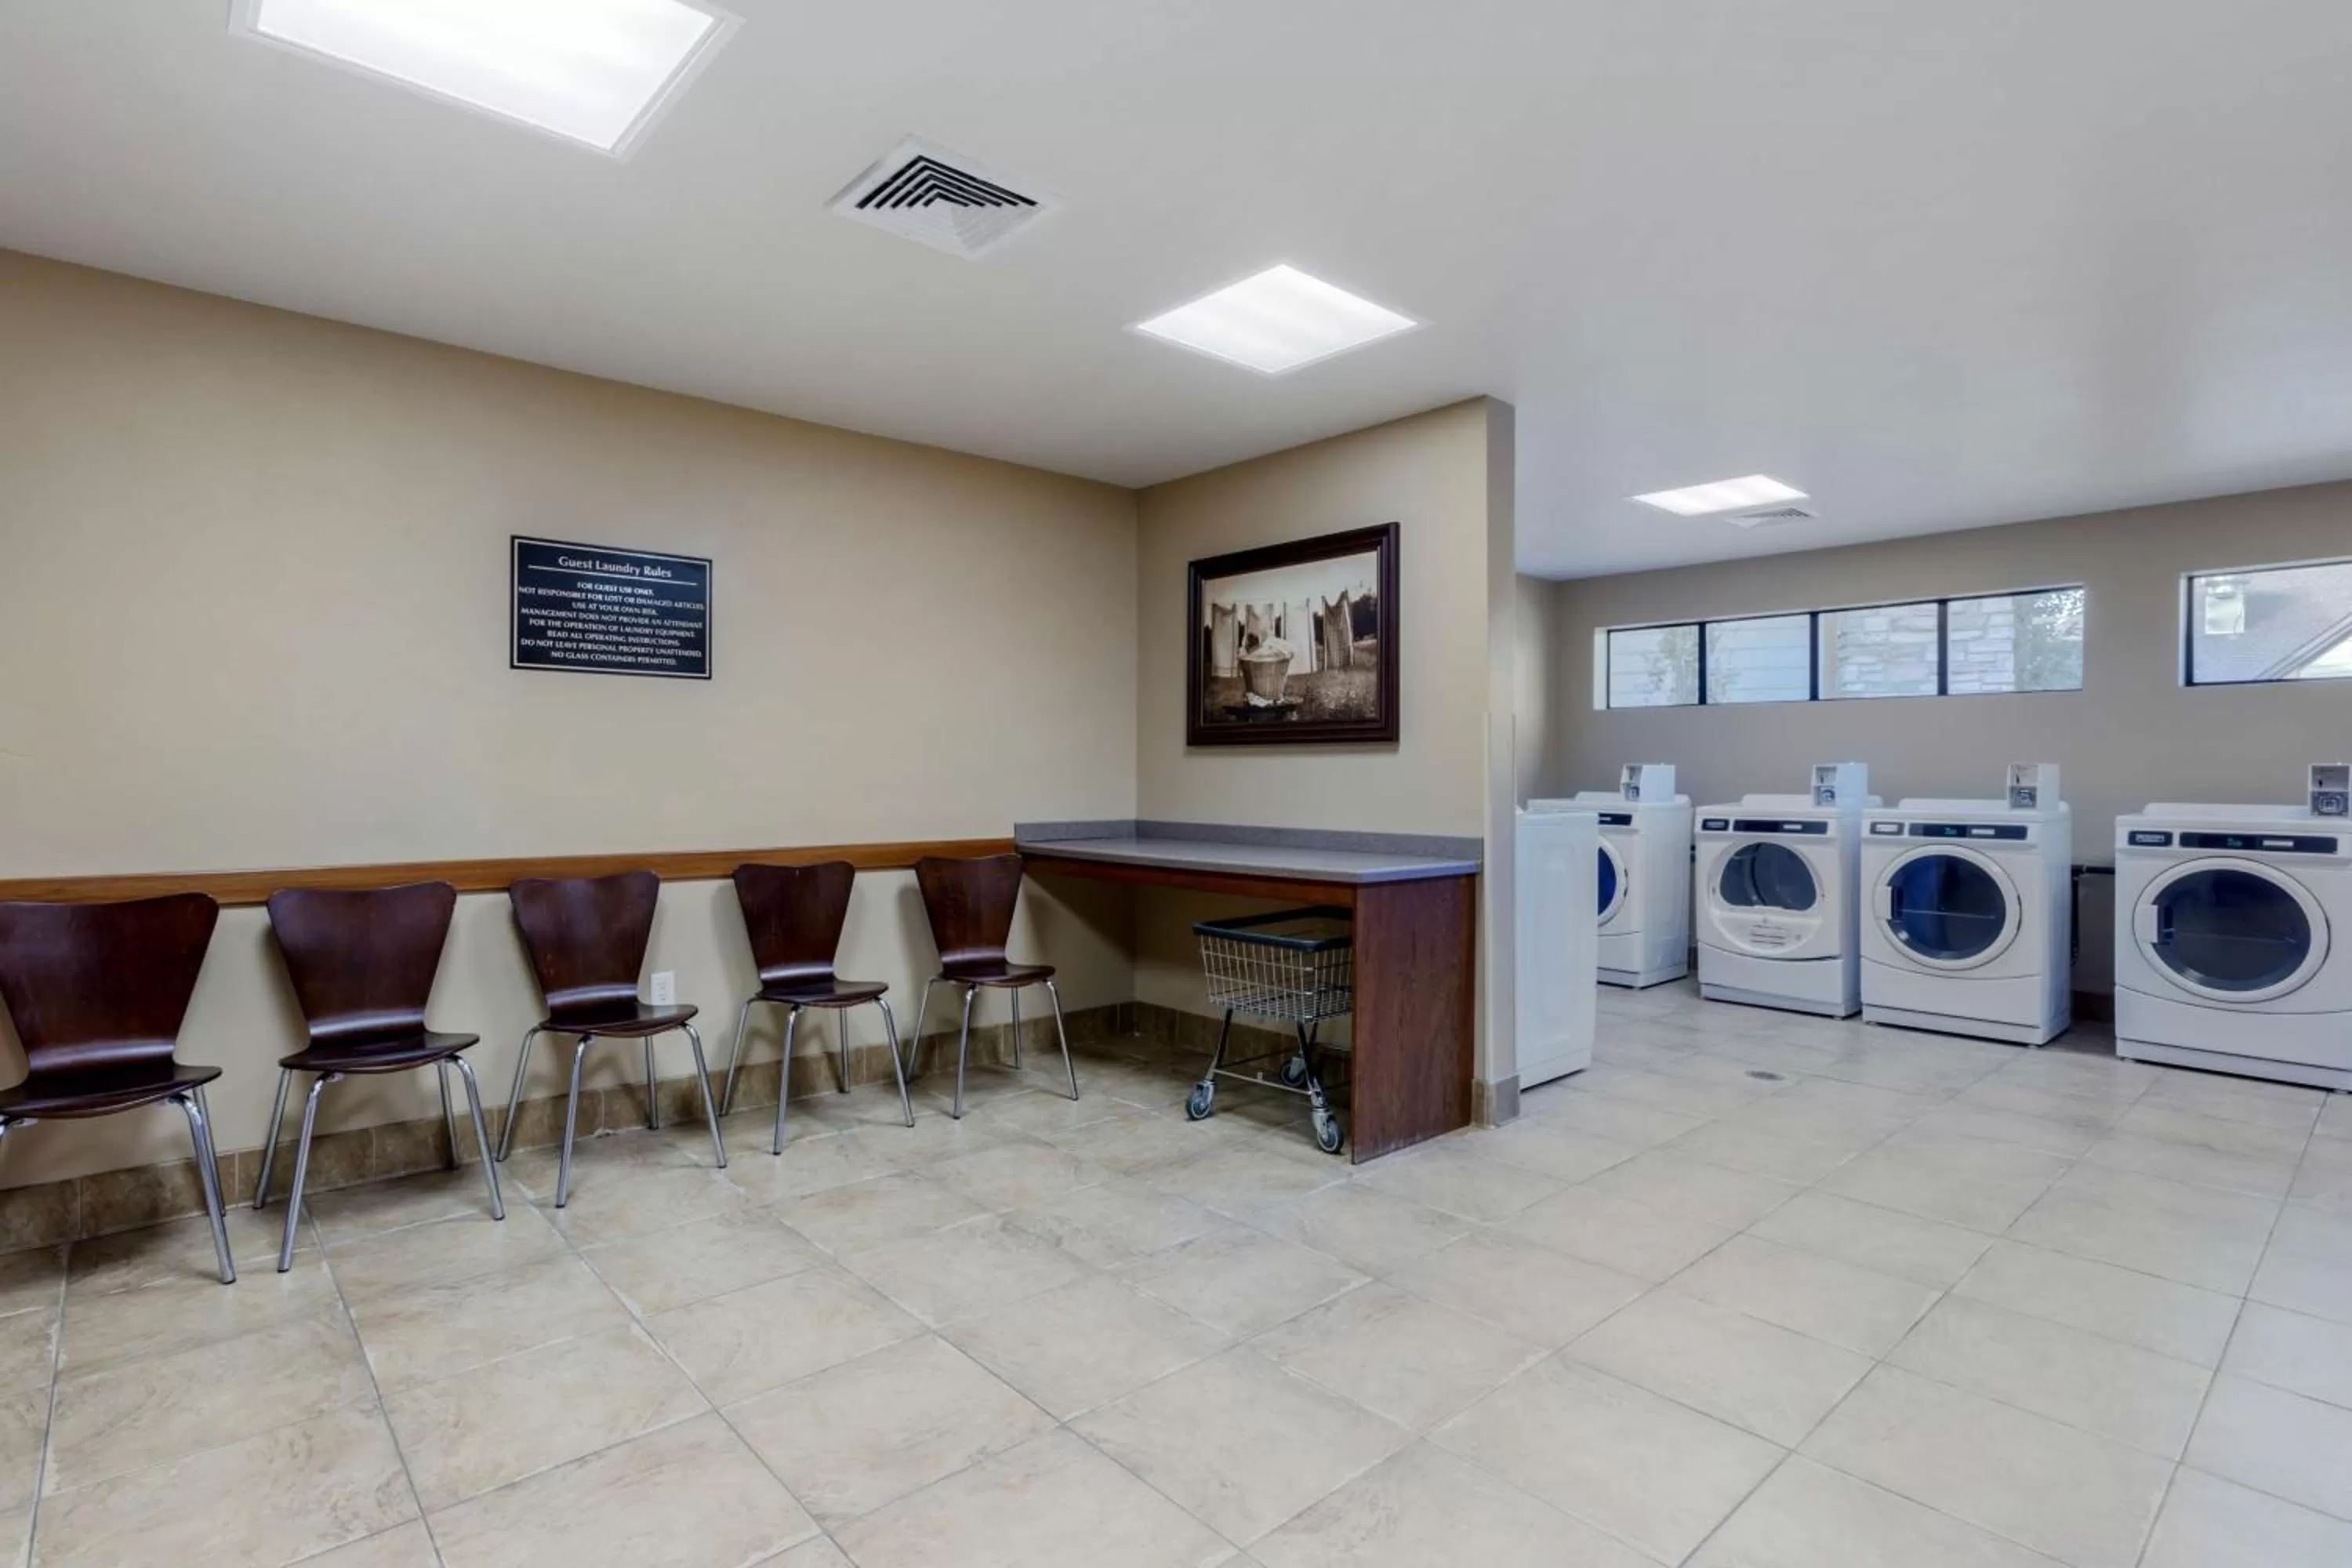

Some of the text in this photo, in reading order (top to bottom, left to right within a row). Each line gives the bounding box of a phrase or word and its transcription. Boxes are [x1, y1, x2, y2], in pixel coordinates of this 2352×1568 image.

[558, 556, 672, 578] Guest Laundry Rules
[594, 583, 617, 592] GUEST
[518, 586, 535, 594] NOT
[604, 594, 622, 603] LOST
[598, 604, 619, 612] YOUR
[529, 618, 546, 626] FOR
[547, 619, 562, 628] THE
[546, 630, 568, 639] READ
[521, 637, 535, 646] DO
[536, 639, 554, 648] NOT
[551, 650, 564, 659] NO
